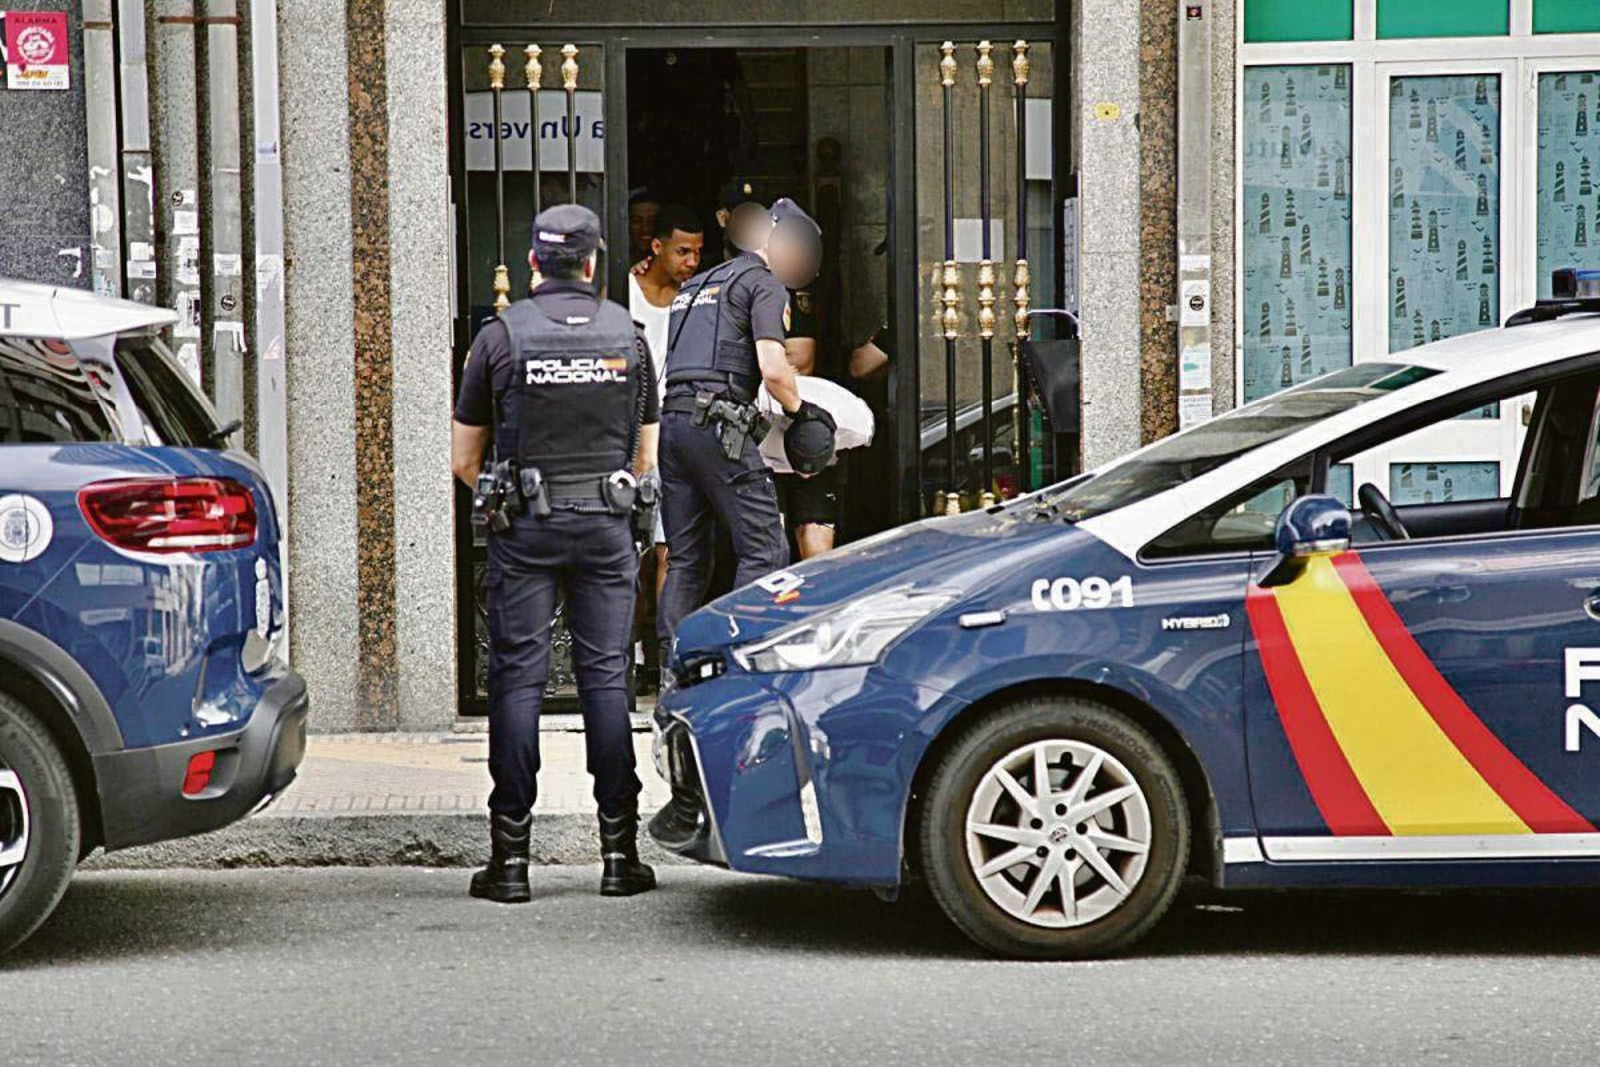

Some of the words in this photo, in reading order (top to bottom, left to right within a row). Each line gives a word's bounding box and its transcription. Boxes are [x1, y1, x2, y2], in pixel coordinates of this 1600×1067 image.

[15, 17, 58, 25] ALARMA
[526, 358, 607, 372] POLICIA
[526, 371, 627, 384] NACIONAL
